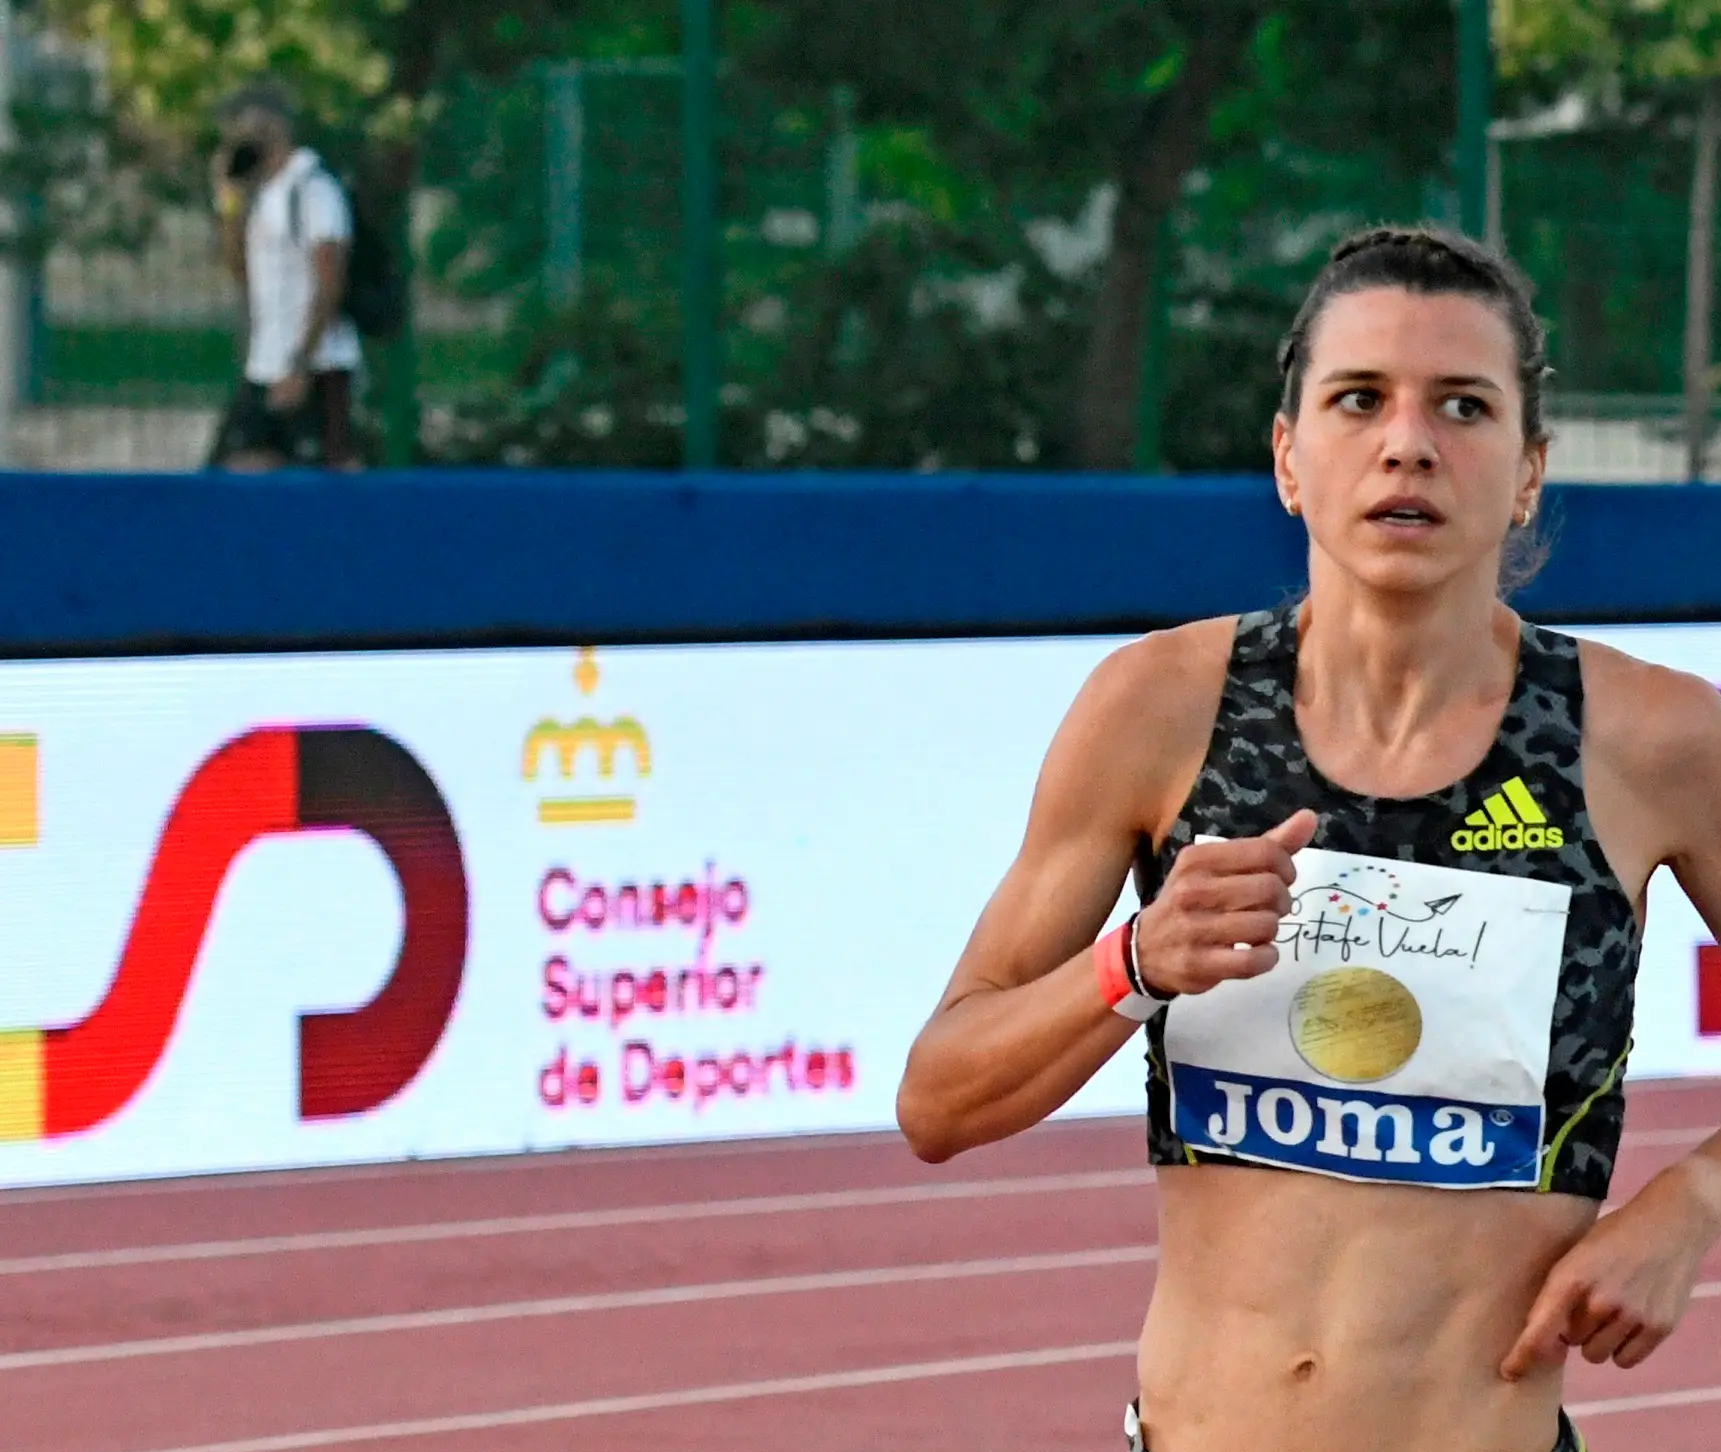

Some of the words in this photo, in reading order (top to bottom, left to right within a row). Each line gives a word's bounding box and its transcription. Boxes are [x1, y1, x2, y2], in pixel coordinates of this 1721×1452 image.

[1450, 822, 1565, 851] adidas
[539, 863, 747, 958] Consejo
[1379, 917, 1487, 969] Vuela!
[542, 953, 763, 1028] Superior
[541, 1043, 598, 1105] de
[622, 1038, 854, 1113] Deportes
